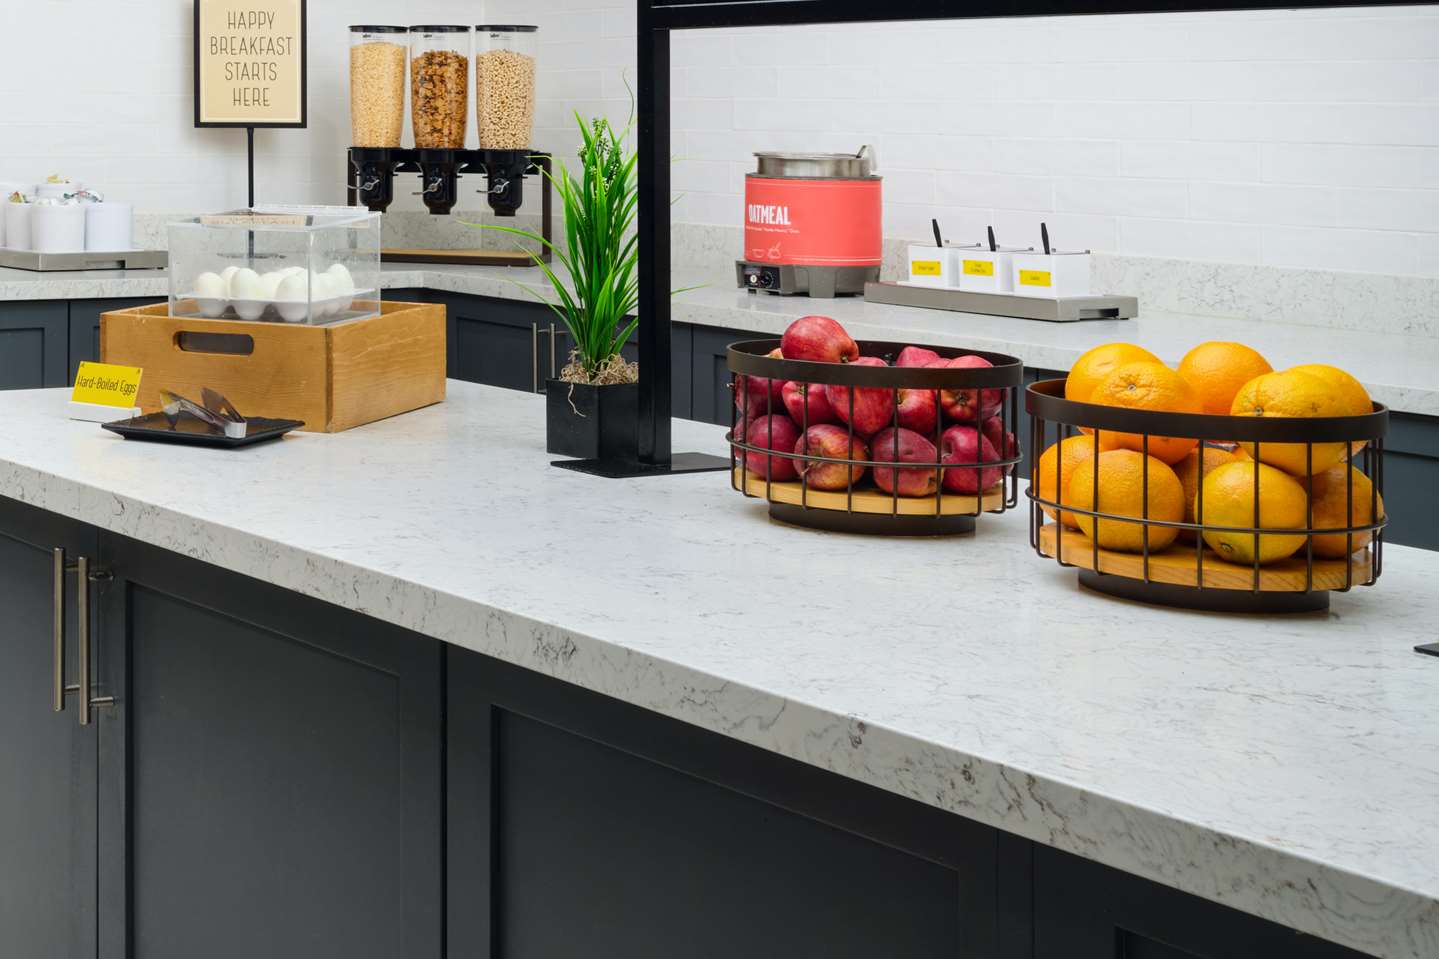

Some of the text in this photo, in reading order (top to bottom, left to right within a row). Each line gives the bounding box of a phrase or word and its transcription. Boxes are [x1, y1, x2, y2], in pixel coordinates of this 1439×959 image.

[227, 11, 275, 30] HAPPY
[210, 36, 293, 55] BREAKFAST
[225, 62, 277, 81] STARTS
[233, 87, 270, 106] HERE
[748, 204, 791, 225] OATMEAL
[77, 375, 137, 396] Hard-Boiled Eggs
